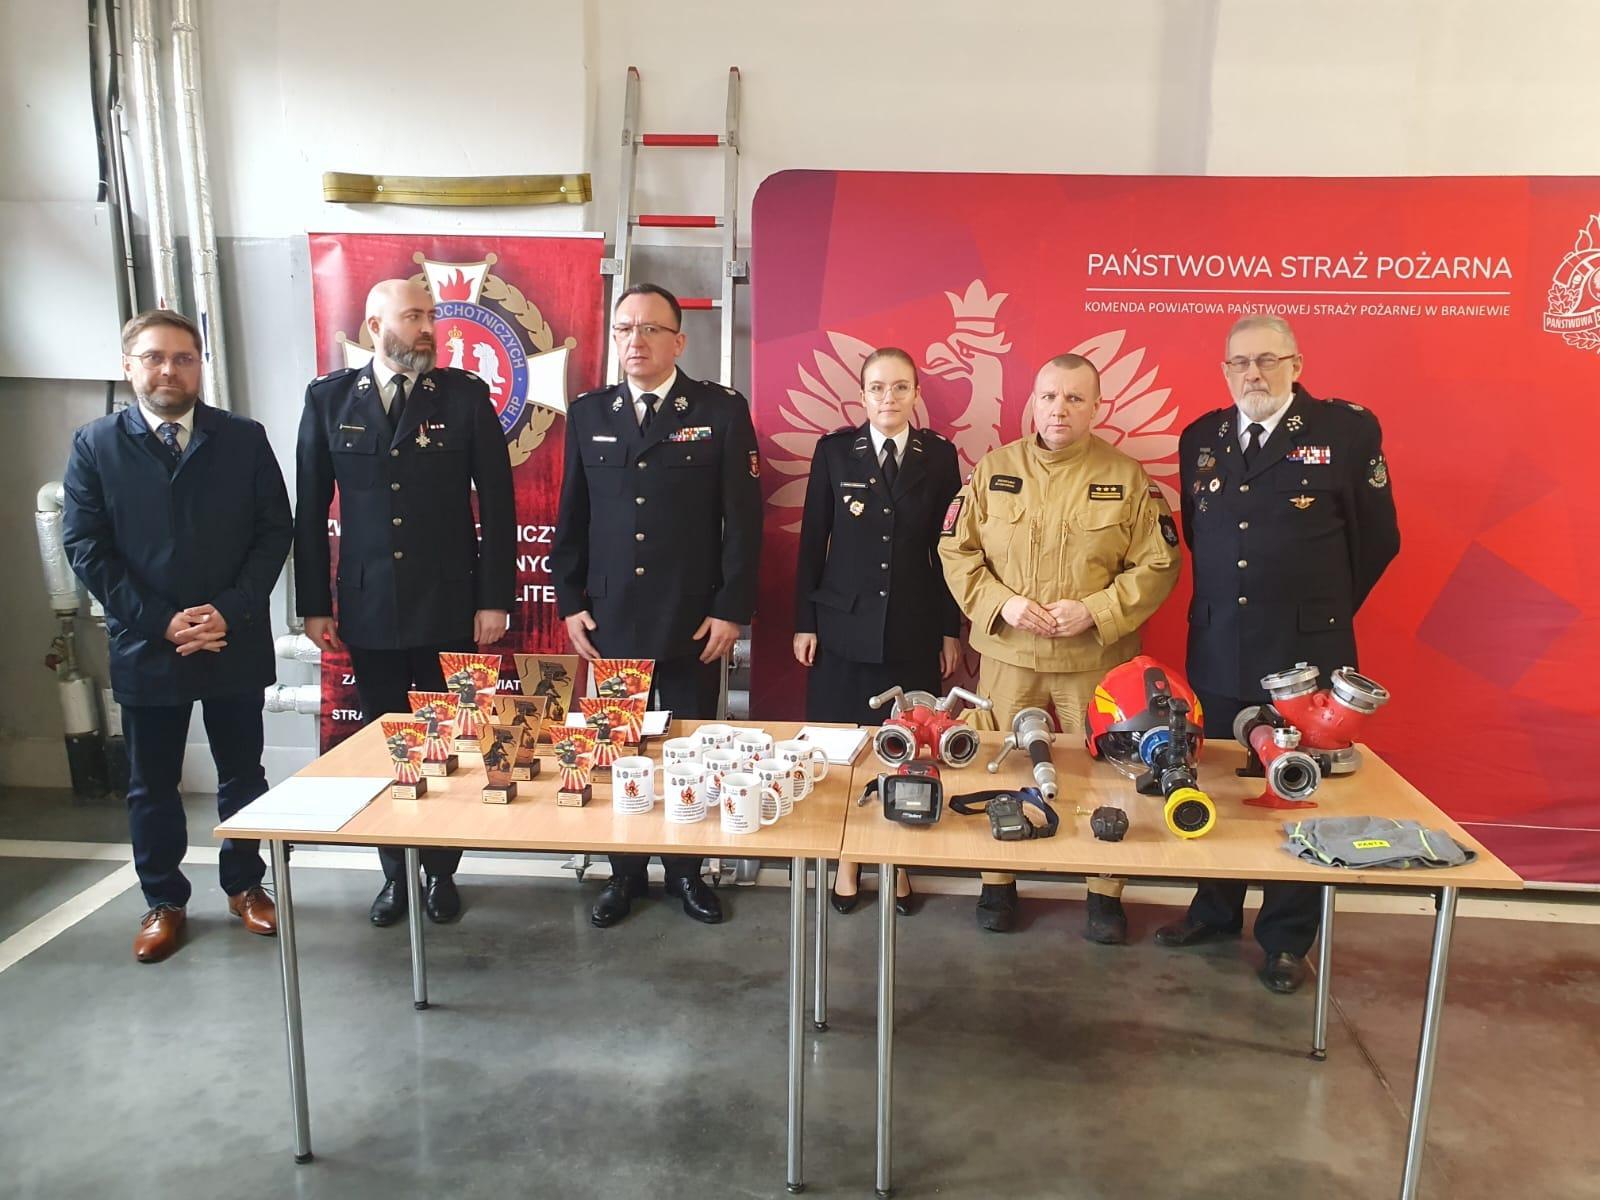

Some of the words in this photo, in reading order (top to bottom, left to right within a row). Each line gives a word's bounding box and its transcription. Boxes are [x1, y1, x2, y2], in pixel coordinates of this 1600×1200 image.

[1087, 248, 1273, 278] PAŃSTWOWA
[1280, 251, 1369, 279] STRAŻ
[1376, 251, 1513, 279] POŻARNA
[1085, 301, 1145, 314] KOMENDA
[1149, 302, 1224, 314] POWIATOWA
[1228, 301, 1310, 315] PAŃSTWOWEJ
[1314, 303, 1357, 316] STRAŻY
[1360, 303, 1421, 316] POŻARNEJ
[1425, 305, 1438, 316] W
[1441, 305, 1511, 317] BRANIEWIE
[434, 304, 525, 369] OCHOTNICZYCH
[510, 396, 522, 416] RP
